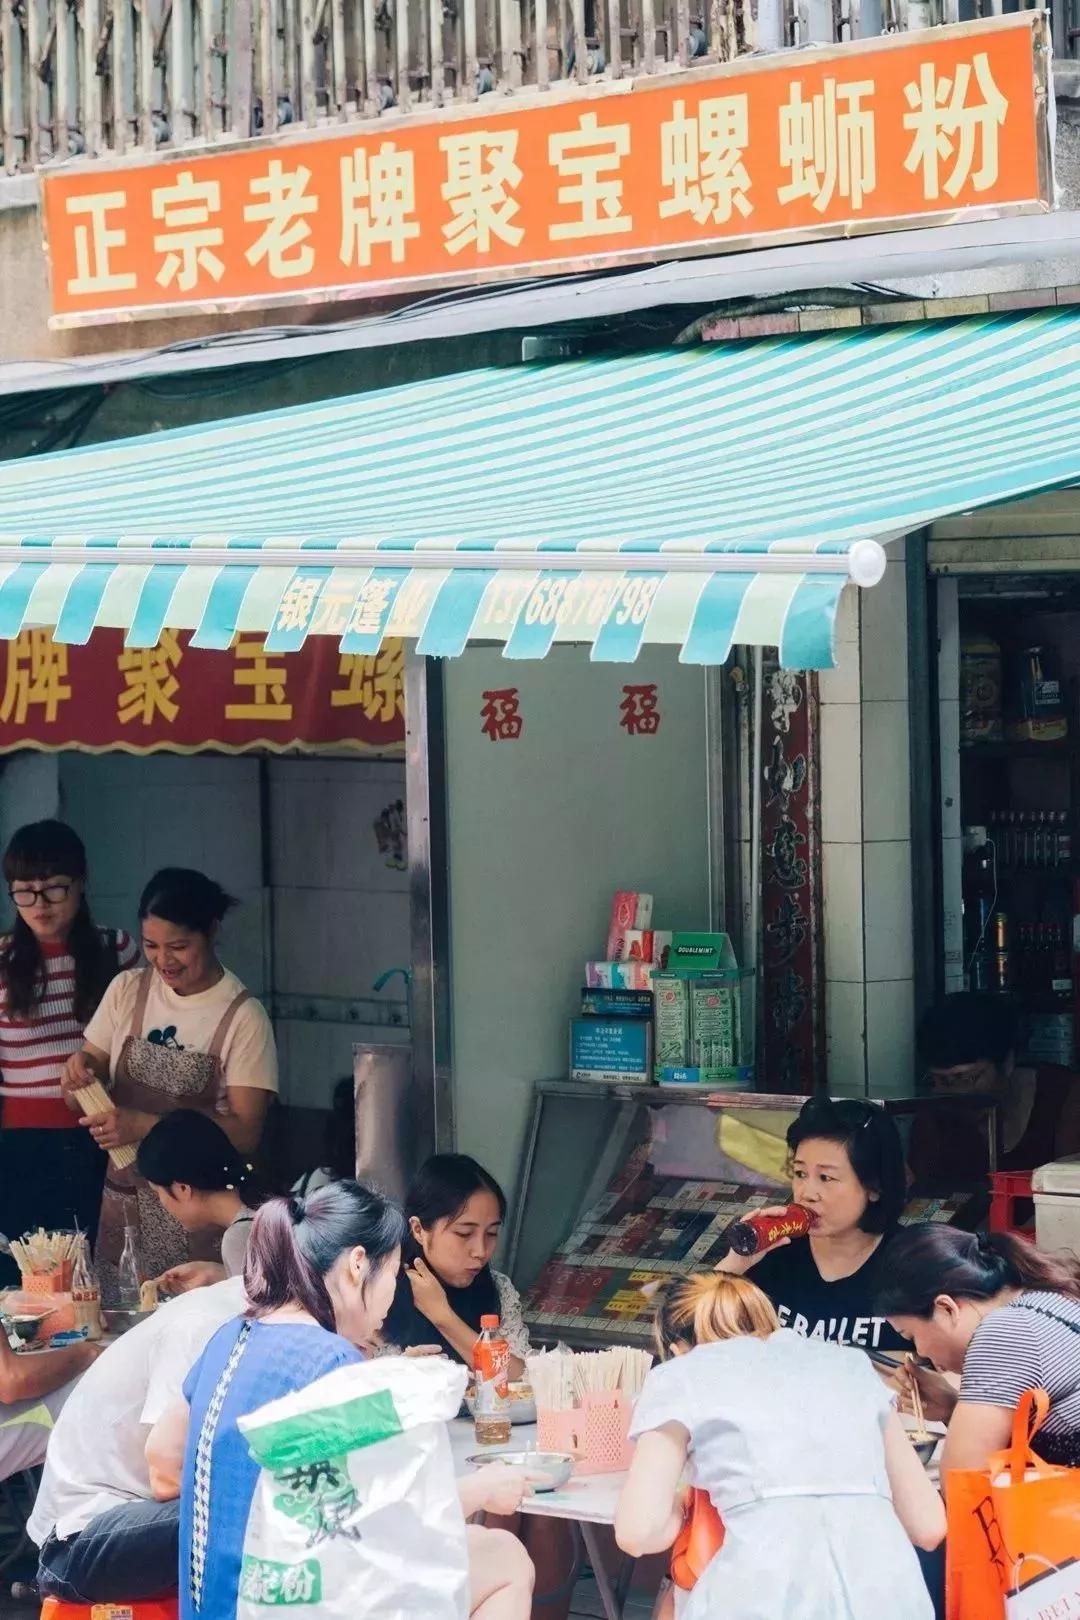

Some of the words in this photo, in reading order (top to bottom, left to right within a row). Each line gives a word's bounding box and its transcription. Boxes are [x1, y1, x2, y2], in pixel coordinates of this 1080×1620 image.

[65, 51, 1010, 296] 正宗老牌聚宝螺蛳粉
[481, 687, 524, 742] 福
[619, 683, 661, 737] 福
[678, 946, 714, 954] DOUBLEMINT
